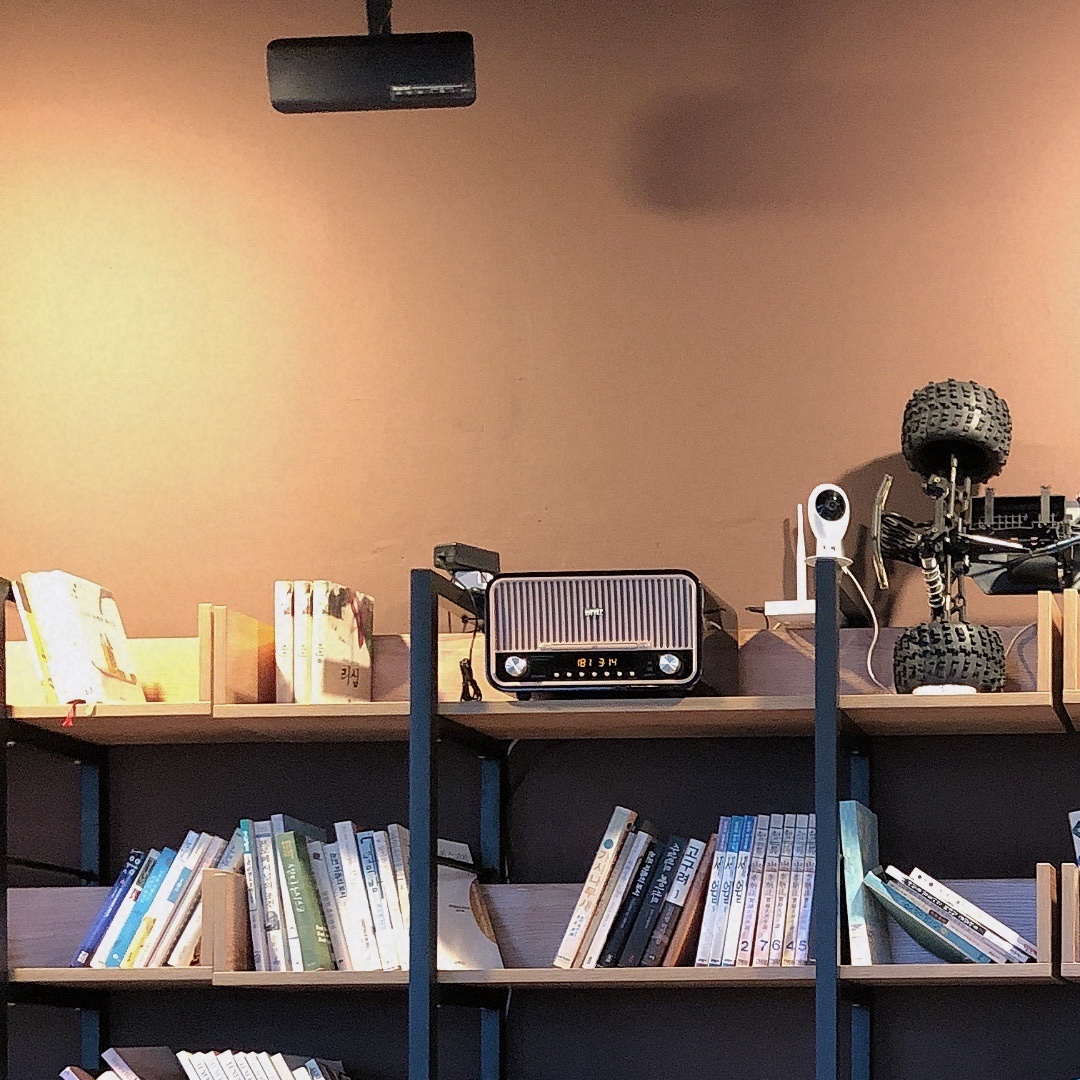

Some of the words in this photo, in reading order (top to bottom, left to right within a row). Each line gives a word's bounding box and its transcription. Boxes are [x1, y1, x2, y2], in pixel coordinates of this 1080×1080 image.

[341, 665, 359, 687] 리심
[740, 940, 749, 952] 2
[760, 940, 769, 952] 7
[772, 940, 781, 951] 6
[786, 940, 796, 950] 4
[798, 940, 807, 950] 5
